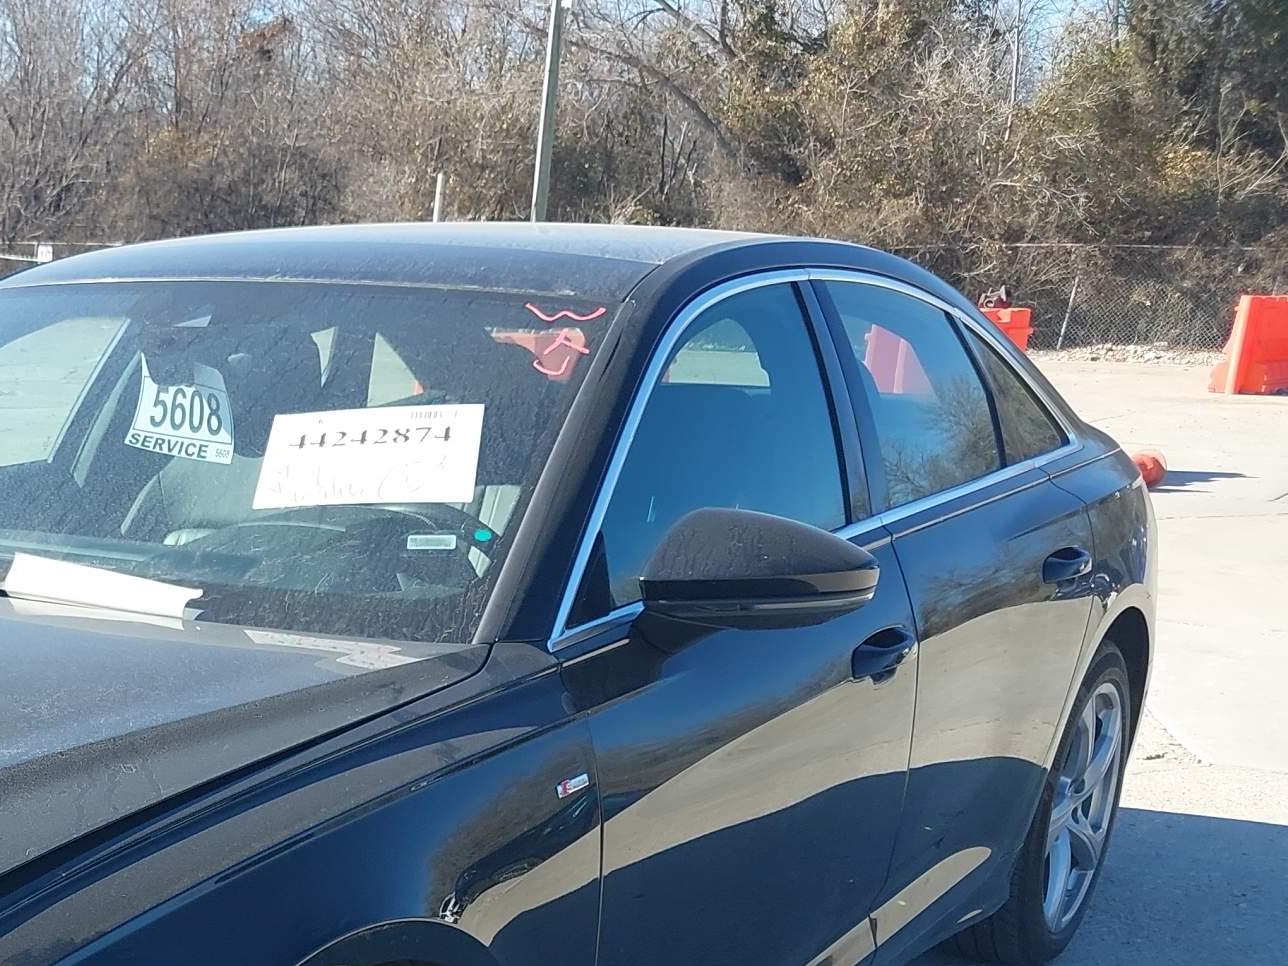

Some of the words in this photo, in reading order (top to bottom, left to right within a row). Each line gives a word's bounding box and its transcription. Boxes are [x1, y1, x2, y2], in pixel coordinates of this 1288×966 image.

[149, 387, 223, 437] 5608
[128, 432, 209, 459] SERVICE
[288, 426, 454, 449] 44242874
